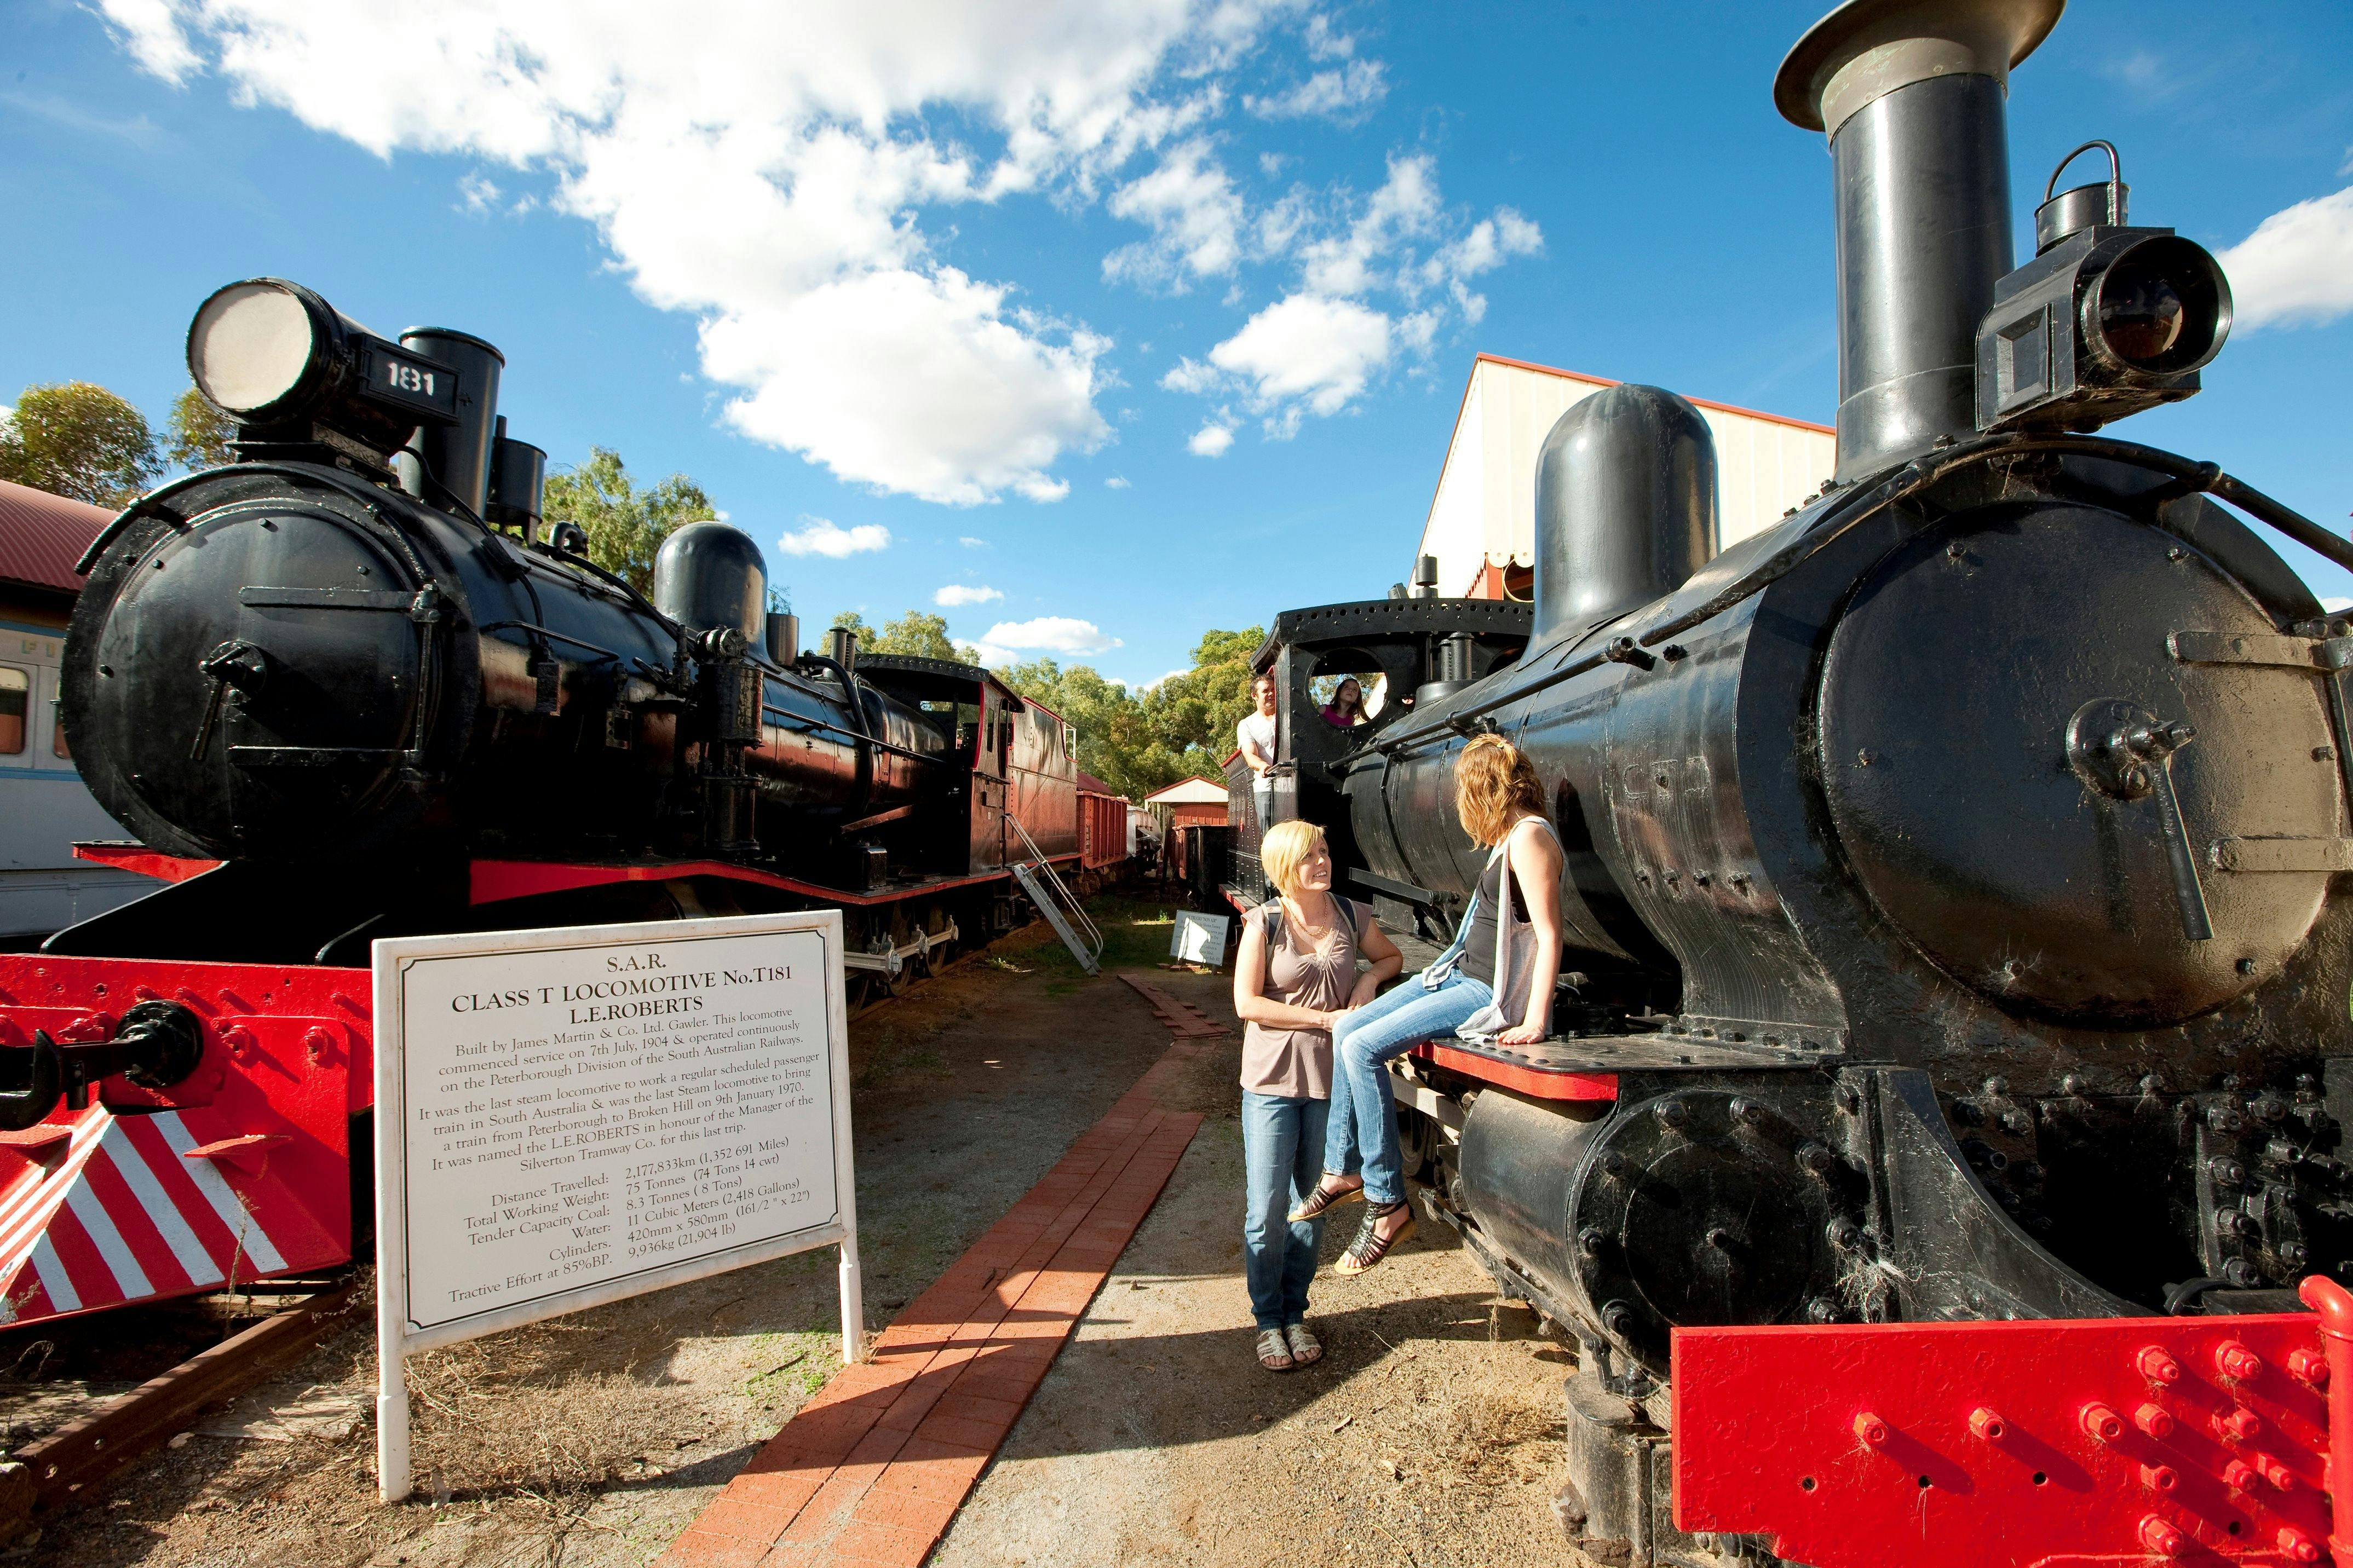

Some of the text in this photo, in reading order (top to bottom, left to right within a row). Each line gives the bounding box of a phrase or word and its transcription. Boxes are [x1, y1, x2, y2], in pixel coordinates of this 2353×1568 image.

[388, 362, 434, 396] 181
[452, 965, 792, 1013] CLASS T LOCOMOTIVE No.T181
[607, 953, 666, 973] S.A.R.
[455, 1008, 792, 1057] Built by James Martin & Co. Ltd. Gawler. This locomotive
[568, 995, 703, 1024] L.E.ROBERTS
[439, 1019, 800, 1076] commenced service on 7th July, 1904 & operated continuously
[440, 1036, 803, 1092] on the Peterborough Division of the South Australian Railways.
[419, 1108, 430, 1120] It
[434, 1107, 459, 1117] was
[464, 1101, 486, 1114] the
[490, 1097, 513, 1109] last
[516, 1093, 551, 1105] steam
[557, 1082, 620, 1099] locomotive
[639, 1073, 667, 1086] work
[681, 1067, 717, 1081] regular
[721, 1057, 770, 1074] scheduled
[774, 1053, 820, 1069] passenger
[433, 1122, 465, 1135] train
[471, 1119, 484, 1129] in
[490, 1110, 528, 1126] South
[532, 1102, 586, 1120] Australia
[591, 1098, 605, 1110] &
[609, 1098, 630, 1107] was
[634, 1092, 652, 1103] the
[655, 1089, 675, 1100] last
[678, 1085, 710, 1096] Steam
[714, 1075, 769, 1091] locomotive
[785, 1069, 811, 1079] bring
[444, 1081, 804, 1151] a train from Peterborough to Broken Hill on 9th January 1970.
[432, 1095, 813, 1171] It was named the L.E.ROBERTS in honour of the Manager of the
[520, 1123, 746, 1171] Silverton Tramway Co. for this last trip.
[463, 1152, 779, 1229] Total Working Weight: 75 Tonnes (74 Tons 14 cwt)
[492, 1136, 789, 1207] Distance Travelled: 2,177,833km (1,352 691 Miles)
[468, 1227, 515, 1246] Tender
[520, 1215, 573, 1233] Capacity
[578, 1204, 609, 1221] Coal:
[626, 1197, 645, 1210] 8.3
[648, 1190, 690, 1206] Tonnes
[711, 1175, 742, 1191] Tons)
[549, 1241, 611, 1261] Cylinders.
[627, 1226, 672, 1243] 420mm
[676, 1223, 683, 1231] x
[687, 1213, 728, 1228] 580mm
[571, 1177, 799, 1239] Water: 11 Cubic Meters (2,418 Gallons)
[448, 1222, 735, 1302] Tractive Effort at 85%BP. 9,936kg (21,904 lb)
